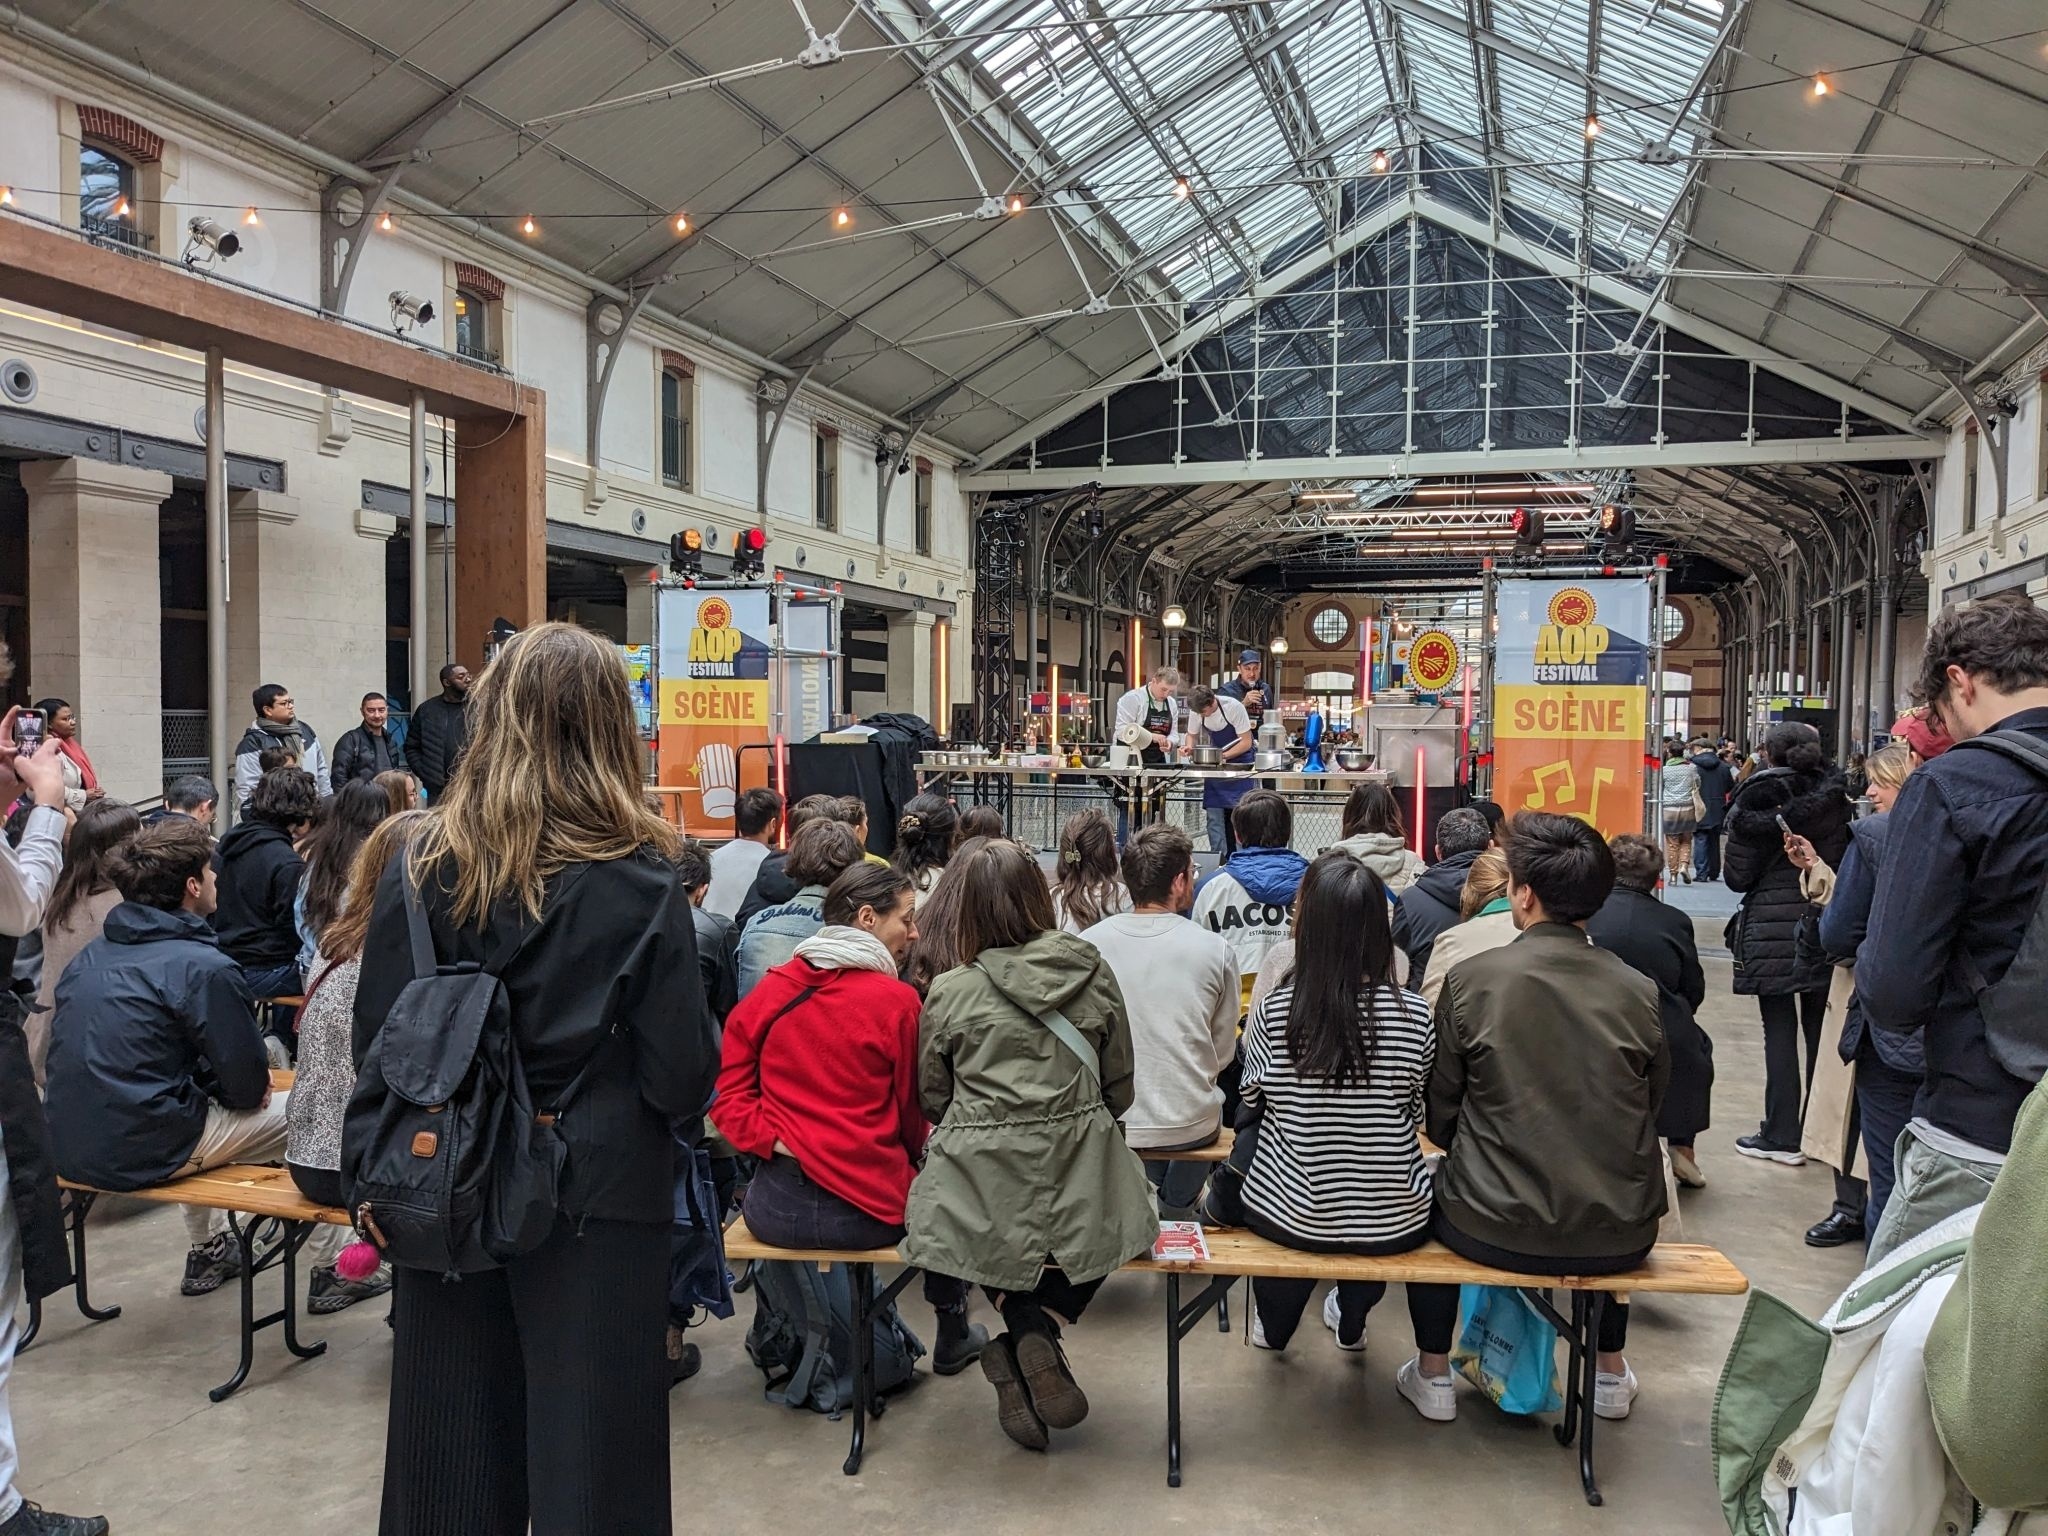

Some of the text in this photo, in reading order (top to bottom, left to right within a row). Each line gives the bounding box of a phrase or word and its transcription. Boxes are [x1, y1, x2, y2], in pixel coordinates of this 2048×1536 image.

[688, 628, 741, 662] AOP
[1534, 624, 1609, 664] AOP
[688, 662, 735, 676] FESTIVAL
[1534, 665, 1598, 681] FESTIVAL
[675, 685, 755, 719] SCÈNE
[1514, 691, 1625, 732] SCÈNE
